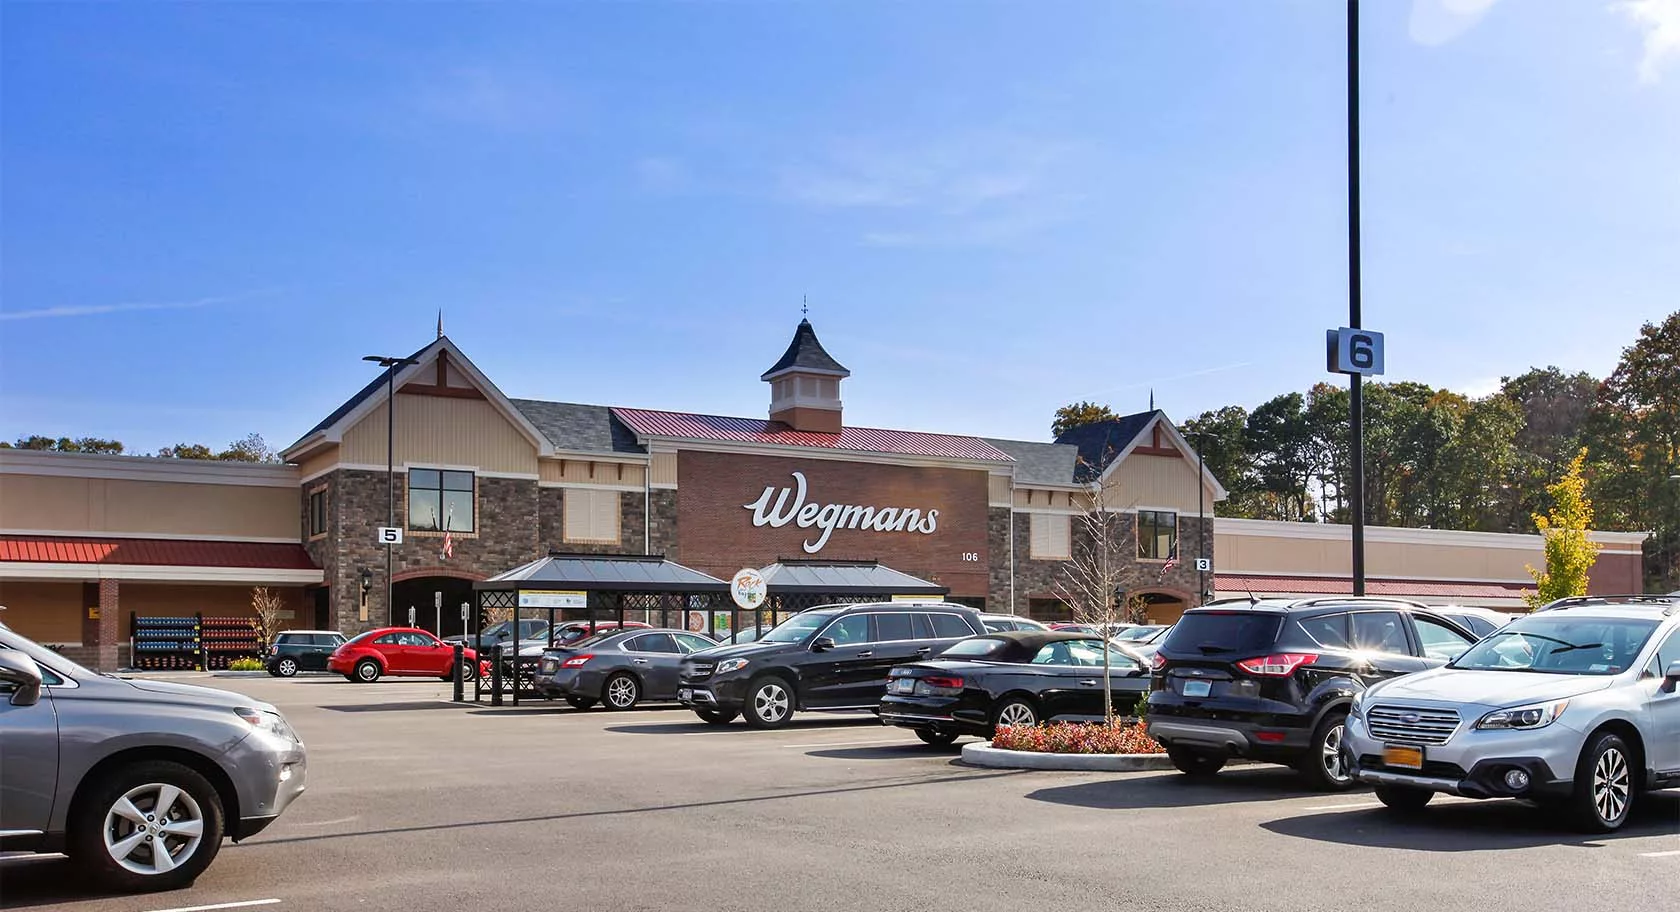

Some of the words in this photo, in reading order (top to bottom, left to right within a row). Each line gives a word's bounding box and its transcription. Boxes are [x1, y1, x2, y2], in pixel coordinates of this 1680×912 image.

[1350, 334, 1373, 368] 6
[743, 471, 939, 553] Wegmans
[384, 529, 397, 541] 5
[962, 552, 978, 561] 106
[1200, 560, 1207, 569] 3
